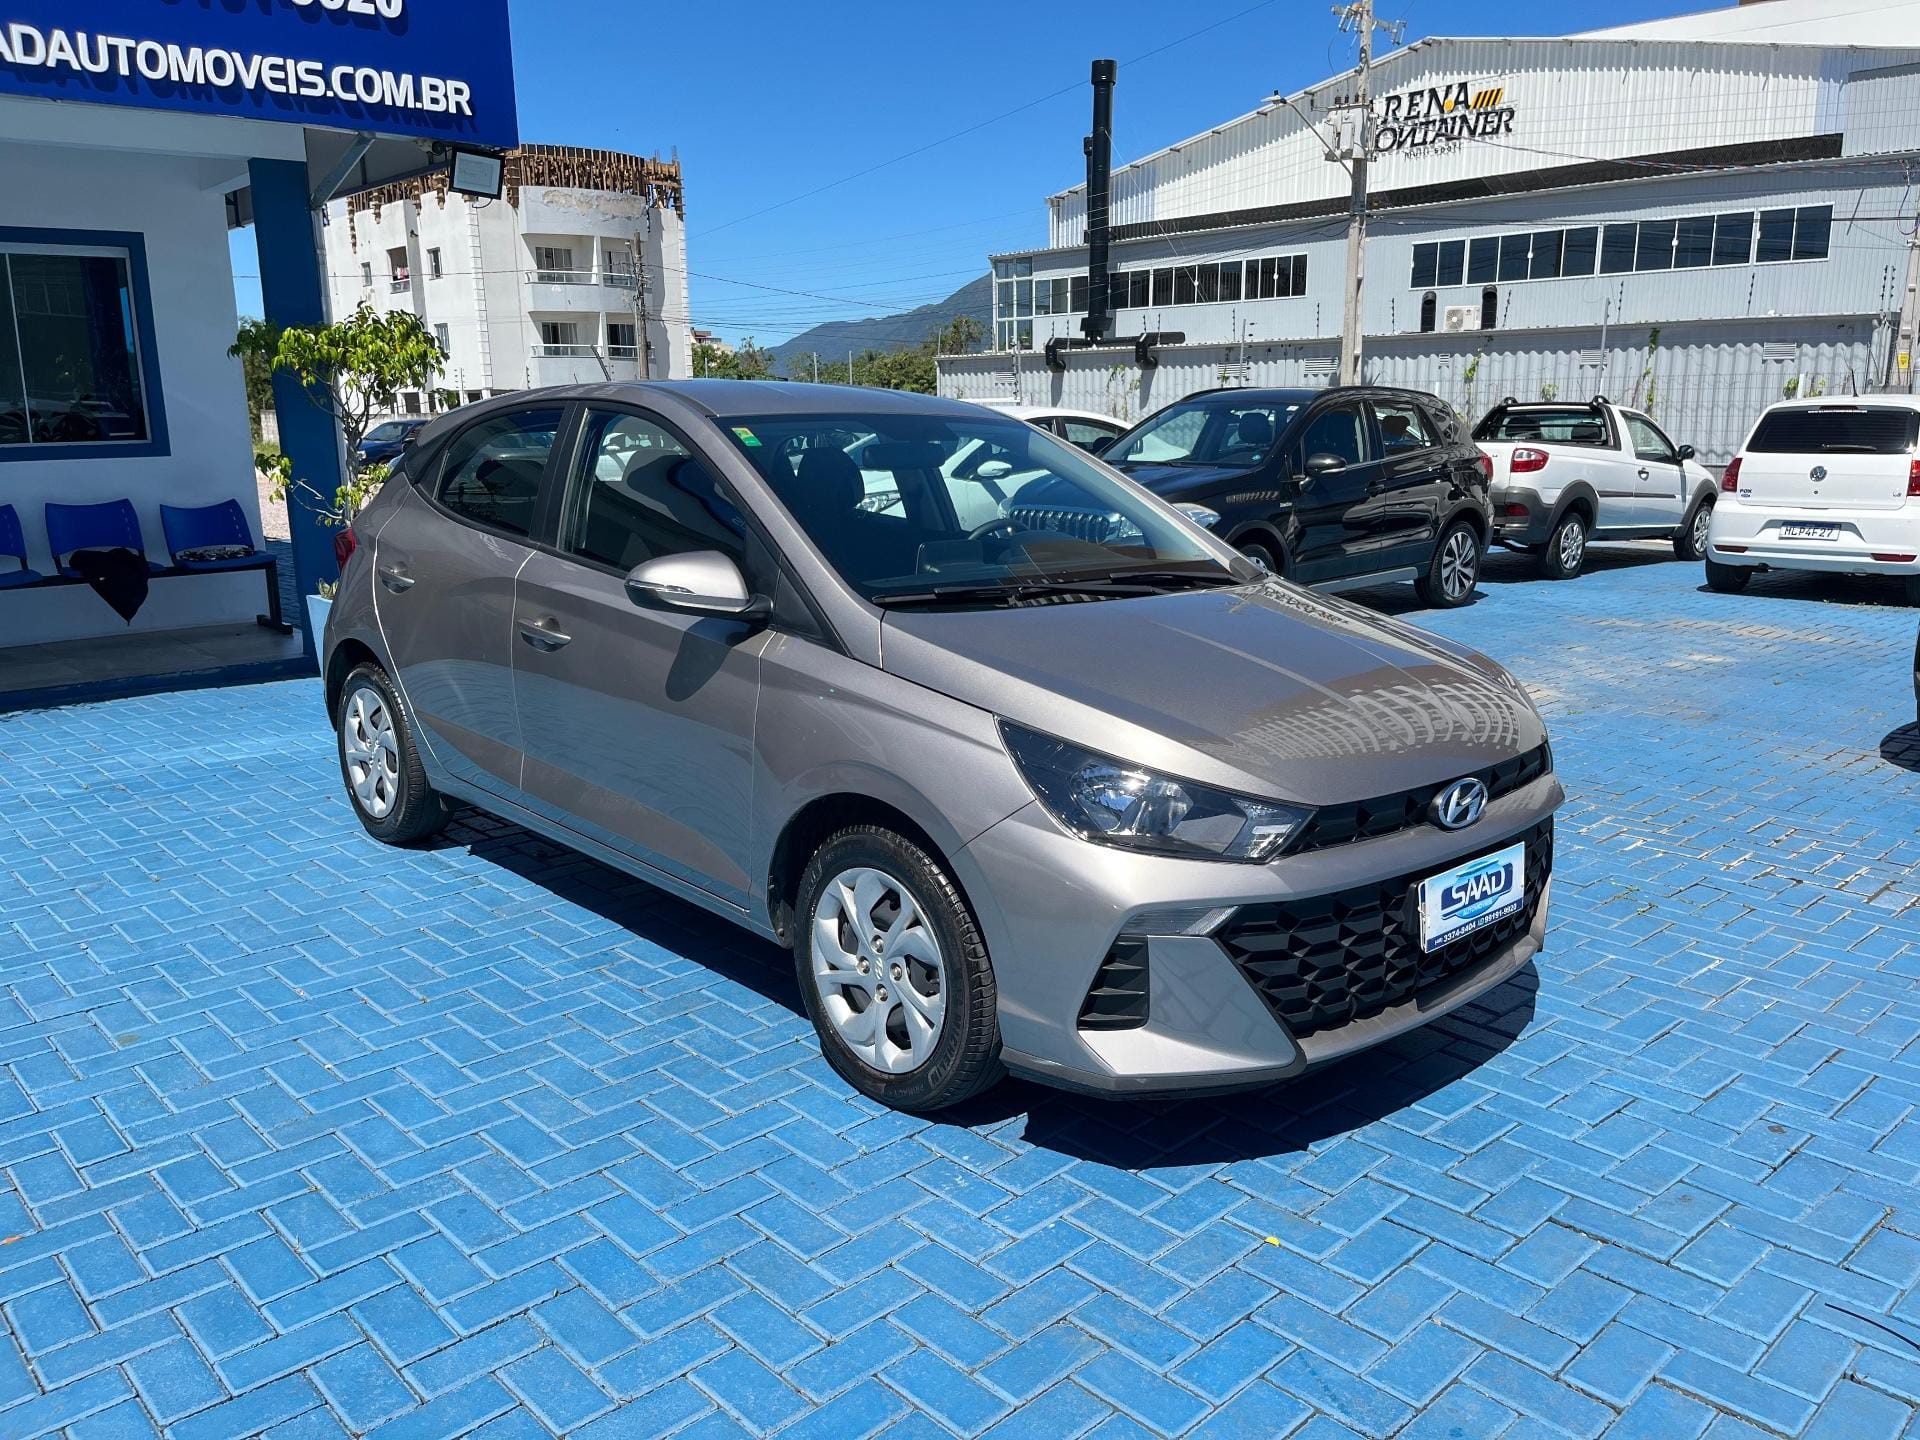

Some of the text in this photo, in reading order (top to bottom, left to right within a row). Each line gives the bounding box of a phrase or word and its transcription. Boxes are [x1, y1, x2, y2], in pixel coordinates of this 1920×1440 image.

[1380, 82, 1471, 125] RENA
[1375, 107, 1515, 153] ONTAINER
[1451, 866, 1506, 907] SAAD
